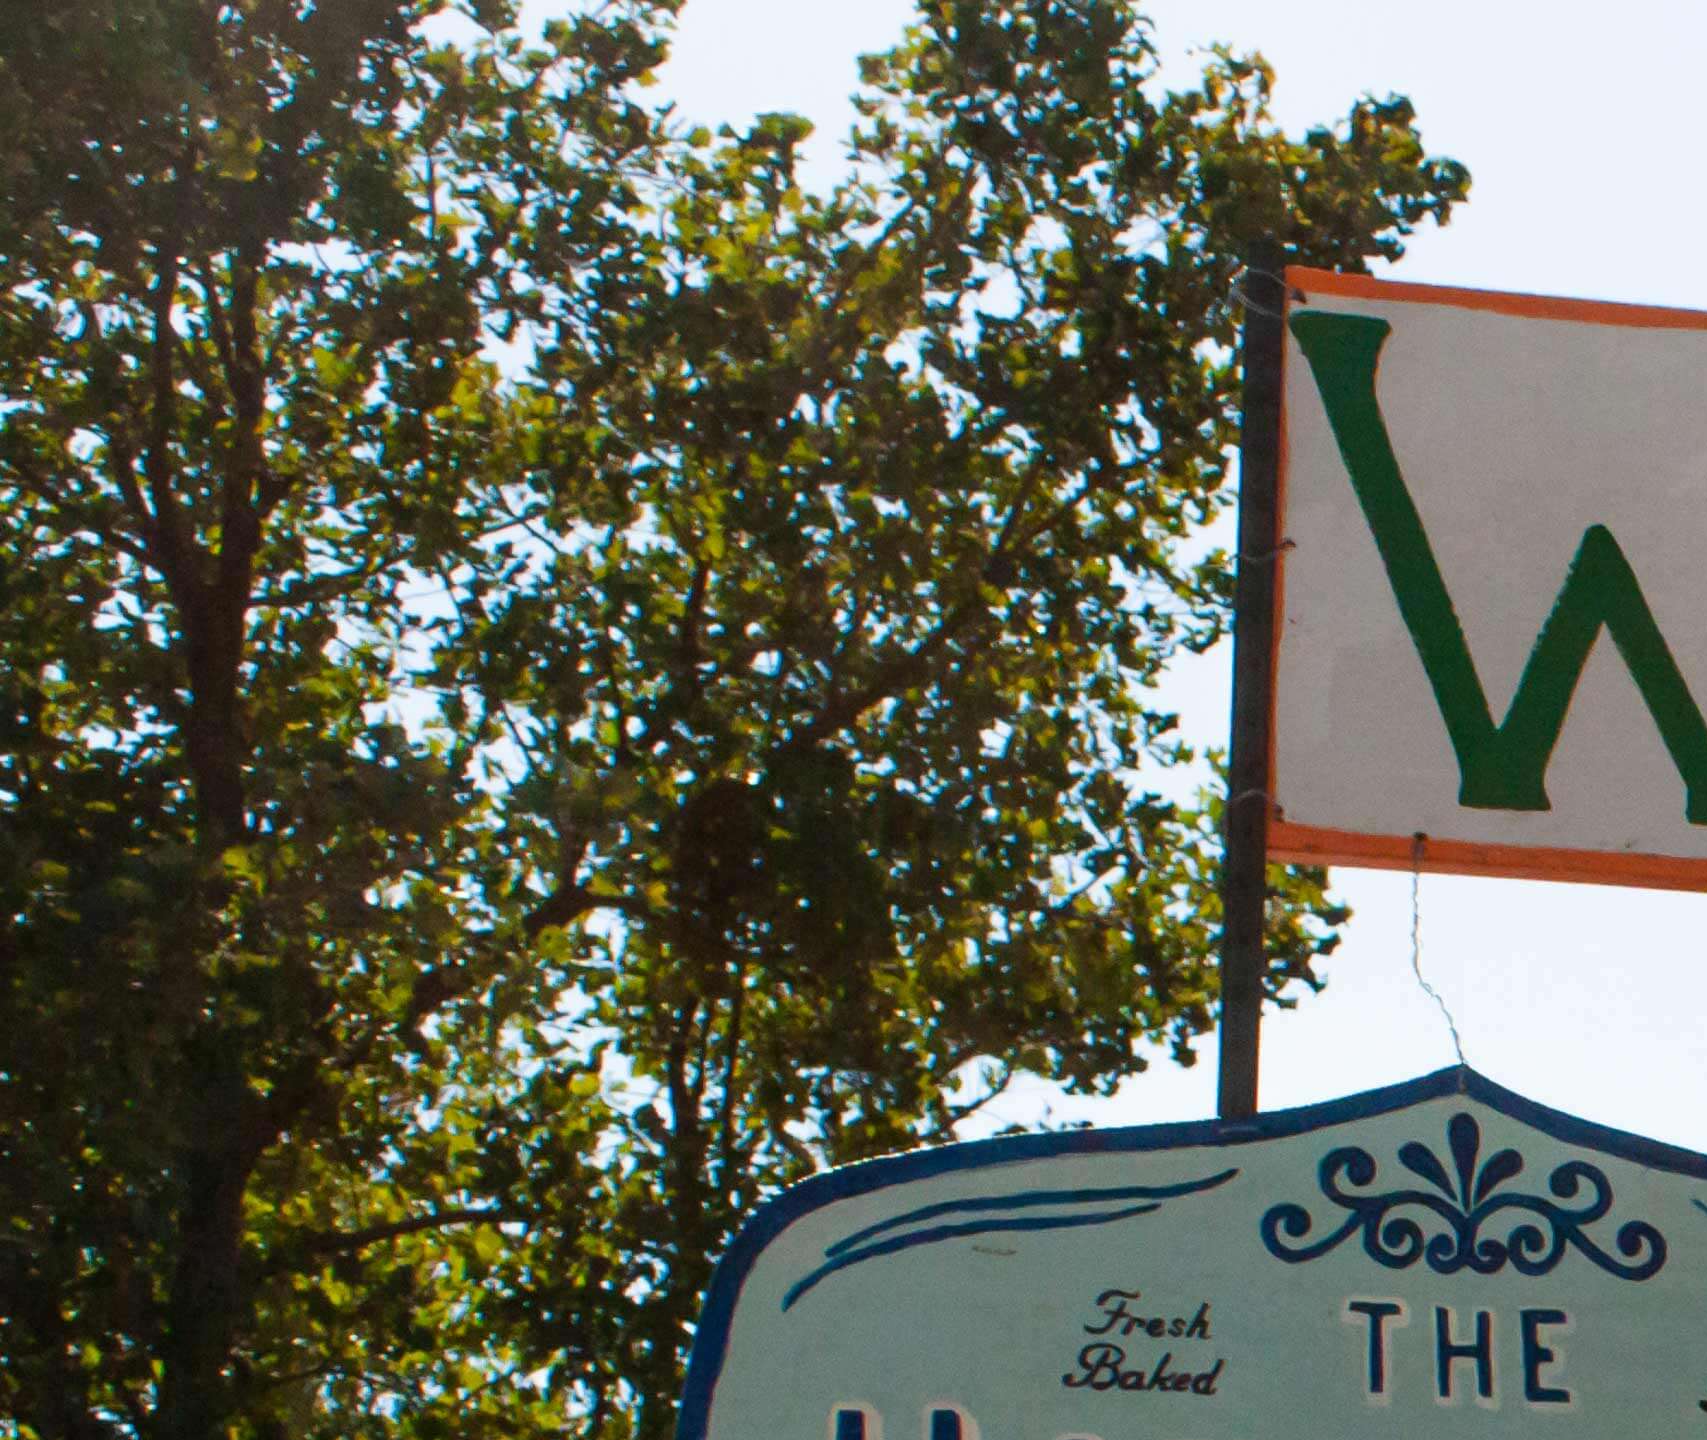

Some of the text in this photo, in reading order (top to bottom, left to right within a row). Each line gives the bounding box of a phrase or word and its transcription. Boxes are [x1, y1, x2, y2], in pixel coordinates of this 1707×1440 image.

[1083, 1289, 1213, 1341] Fresh
[1062, 1344, 1219, 1397] Baked
[1350, 1302, 1572, 1402] THE
